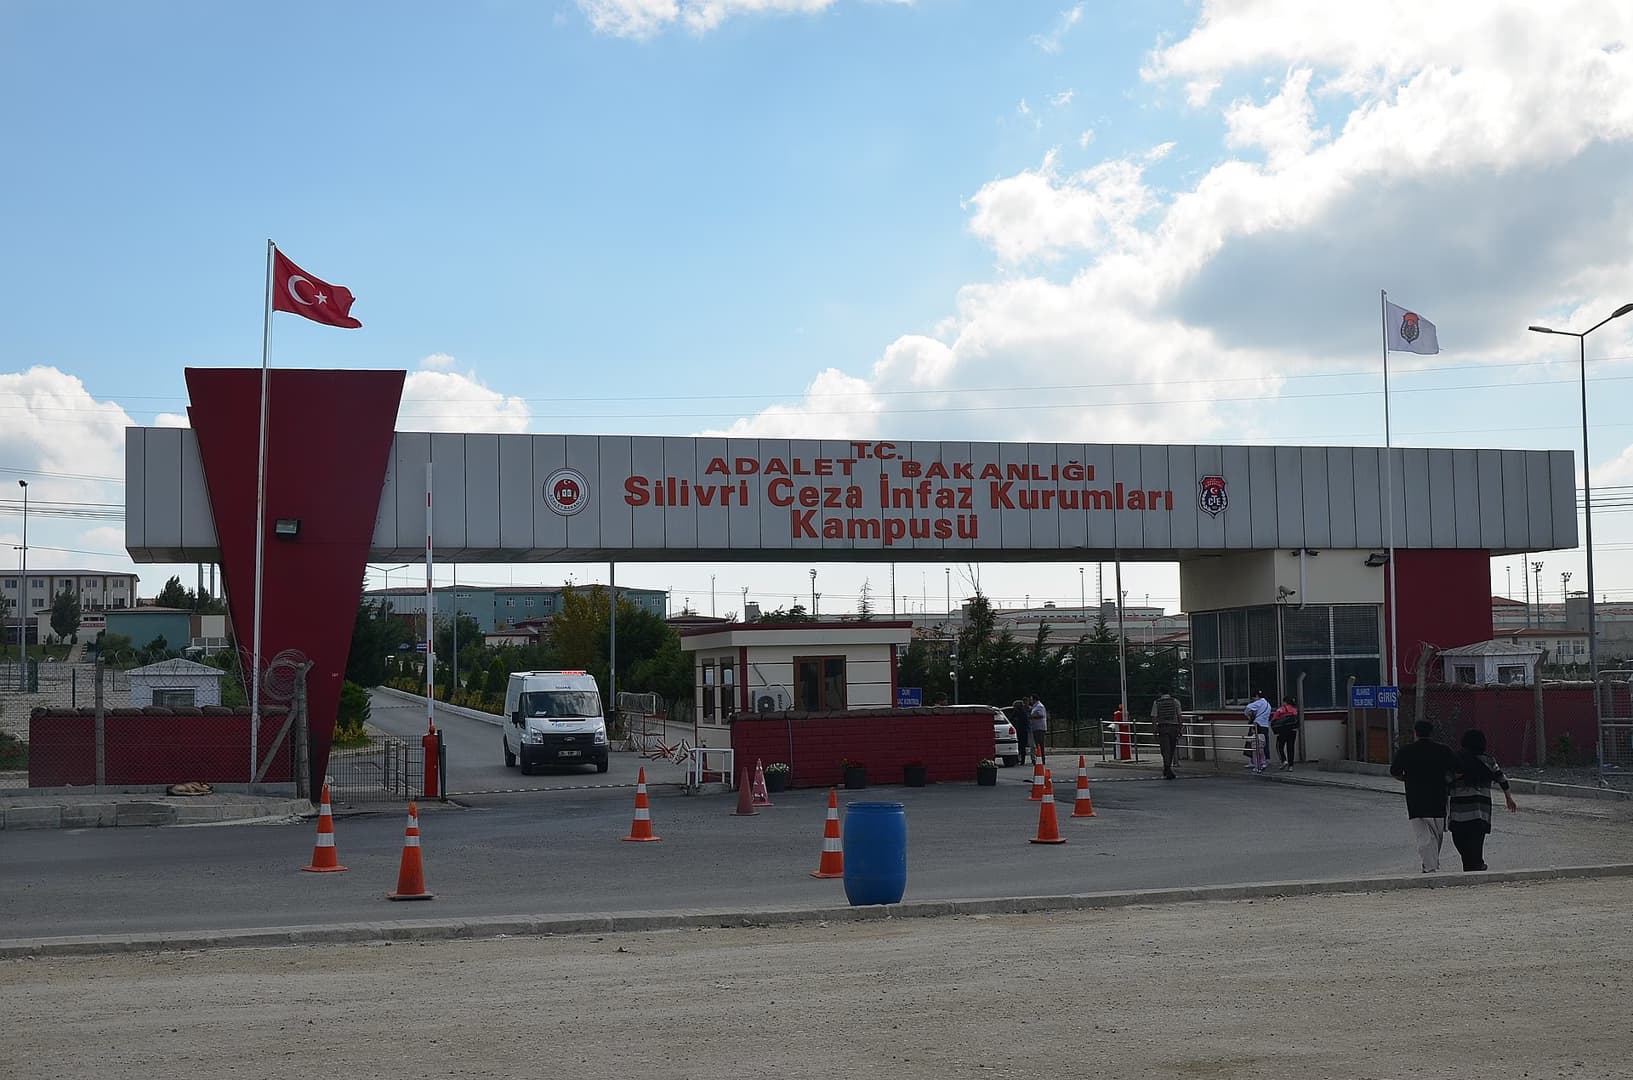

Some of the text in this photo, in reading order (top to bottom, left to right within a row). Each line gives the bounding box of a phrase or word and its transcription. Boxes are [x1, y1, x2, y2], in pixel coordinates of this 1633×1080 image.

[852, 442, 904, 459] T.C.
[705, 458, 1095, 480] ADALET BAKANLIĞI
[624, 473, 1173, 511] Silivri Ceza İnfaz Kurumları
[792, 510, 978, 545] Kampusü
